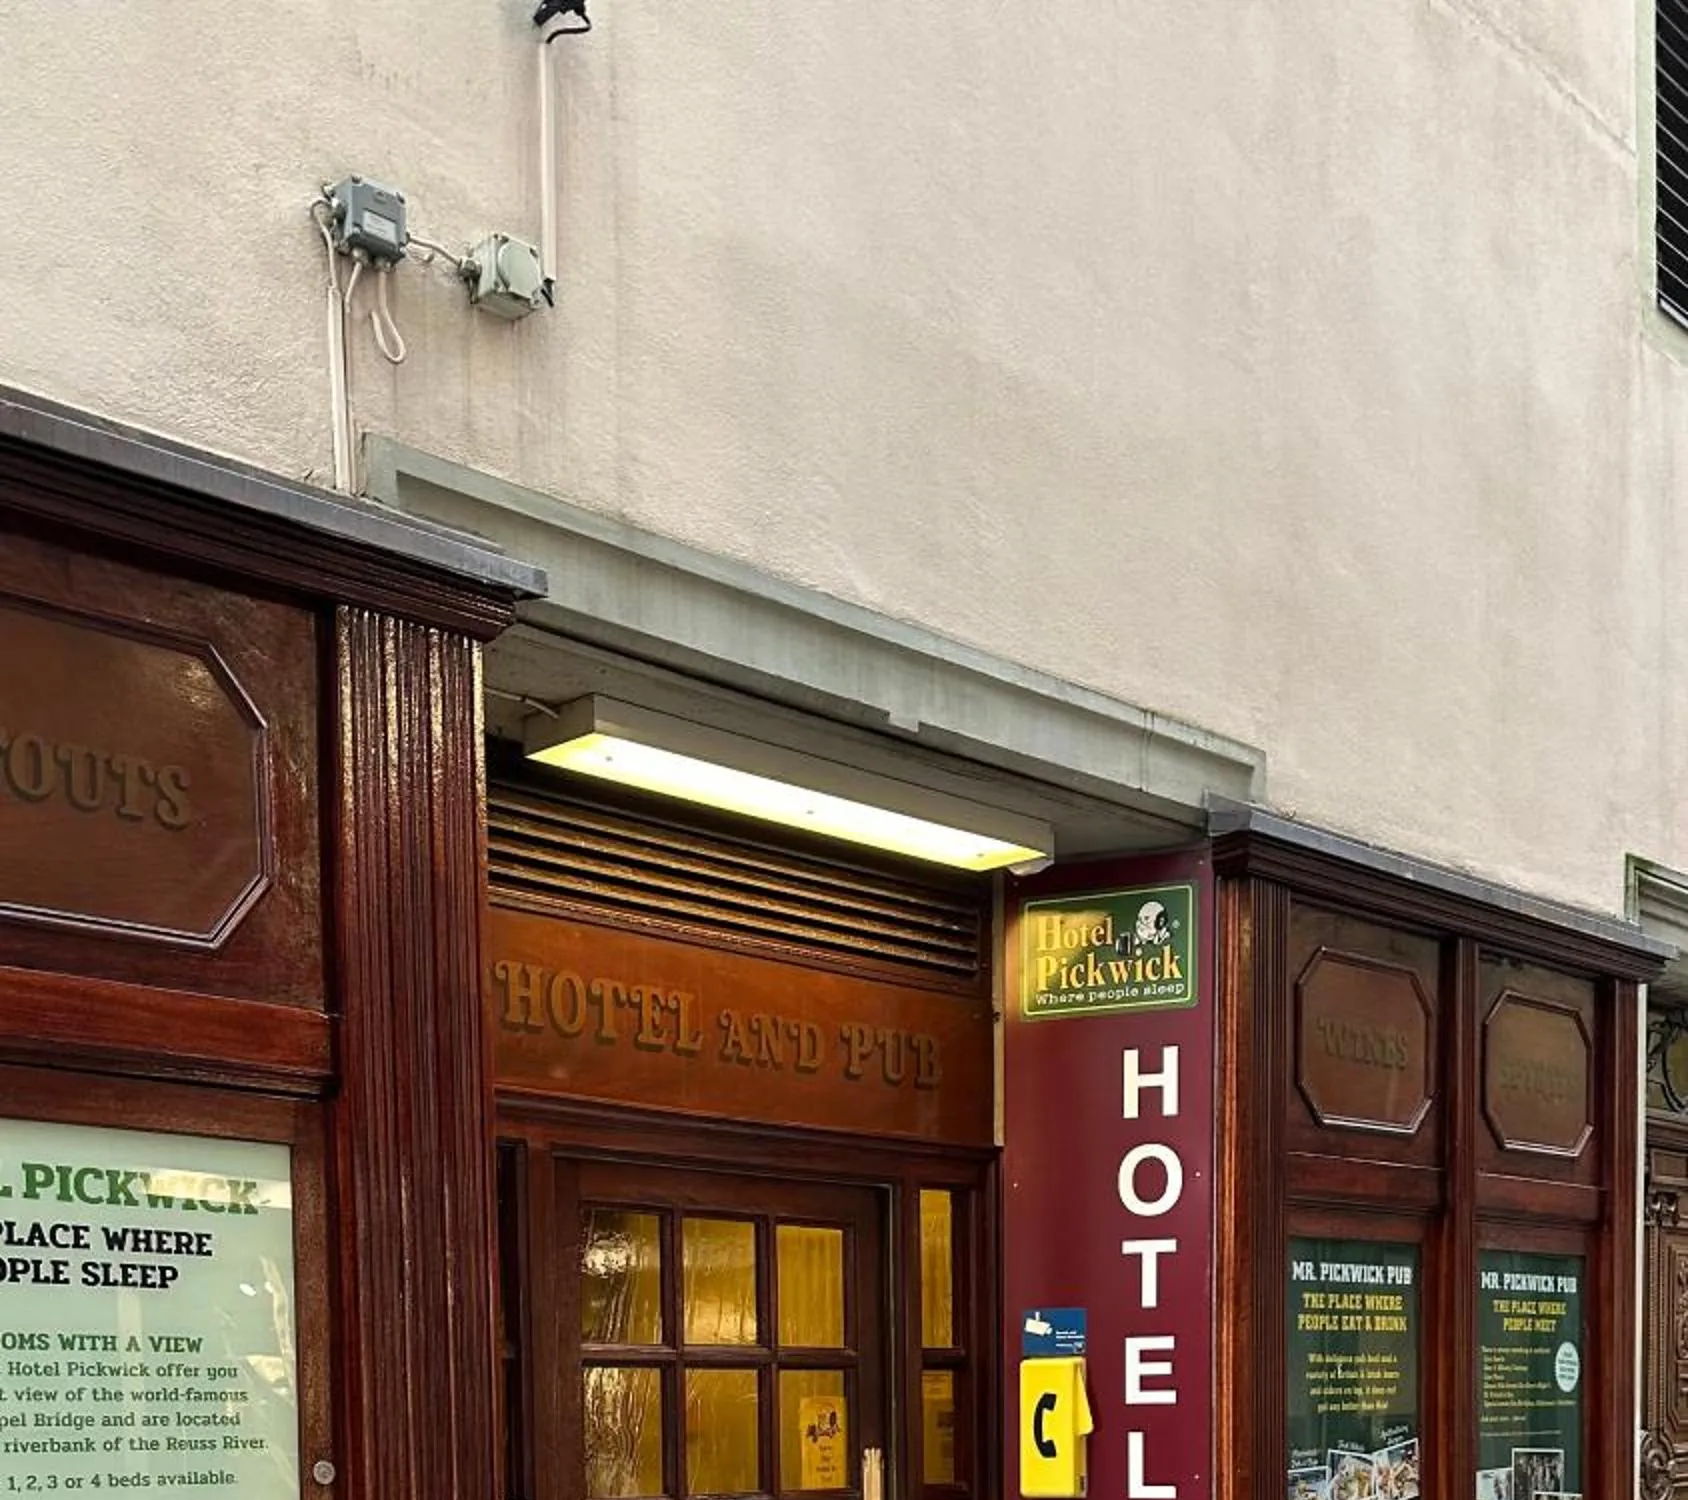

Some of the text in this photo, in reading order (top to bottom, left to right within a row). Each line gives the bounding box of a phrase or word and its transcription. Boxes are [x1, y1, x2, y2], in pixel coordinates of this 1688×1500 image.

[0, 732, 191, 829] OUTS
[1036, 915, 1113, 951] Hotel
[1036, 945, 1182, 991] Pickwick
[1088, 986, 1138, 1002] people
[1143, 983, 1185, 997] sleep
[494, 959, 943, 1087] HOTEL AND PUB
[0, 1220, 212, 1257] LACE WHERE
[81, 1261, 179, 1288] SLEEP
[1118, 1046, 1183, 1499] HOTEL
[1292, 1261, 1412, 1285] MR. PICKWICK PUB
[1503, 1273, 1555, 1293] PICKWICK
[1303, 1293, 1403, 1311] THE PLACE WHERE
[1297, 1313, 1339, 1331] PEOPLE
[1341, 1315, 1363, 1331] EAT
[1, 1332, 203, 1353] OMS WITH A VIEW
[8, 1361, 238, 1381] Hotel Pickwick offer you
[14, 1387, 58, 1401] view
[65, 1387, 87, 1401] of
[92, 1387, 124, 1401] the
[131, 1387, 249, 1402] world-famous
[34, 1412, 95, 1430] Bridge
[101, 1412, 135, 1427] and
[142, 1415, 170, 1427] are
[176, 1412, 241, 1427] located
[4, 1437, 97, 1453] riverbank
[103, 1436, 124, 1451] of
[129, 1437, 160, 1451] the
[47, 1474, 58, 1489] 3
[64, 1477, 84, 1489] or
[90, 1473, 101, 1489] 4
[107, 1471, 150, 1488] beds
